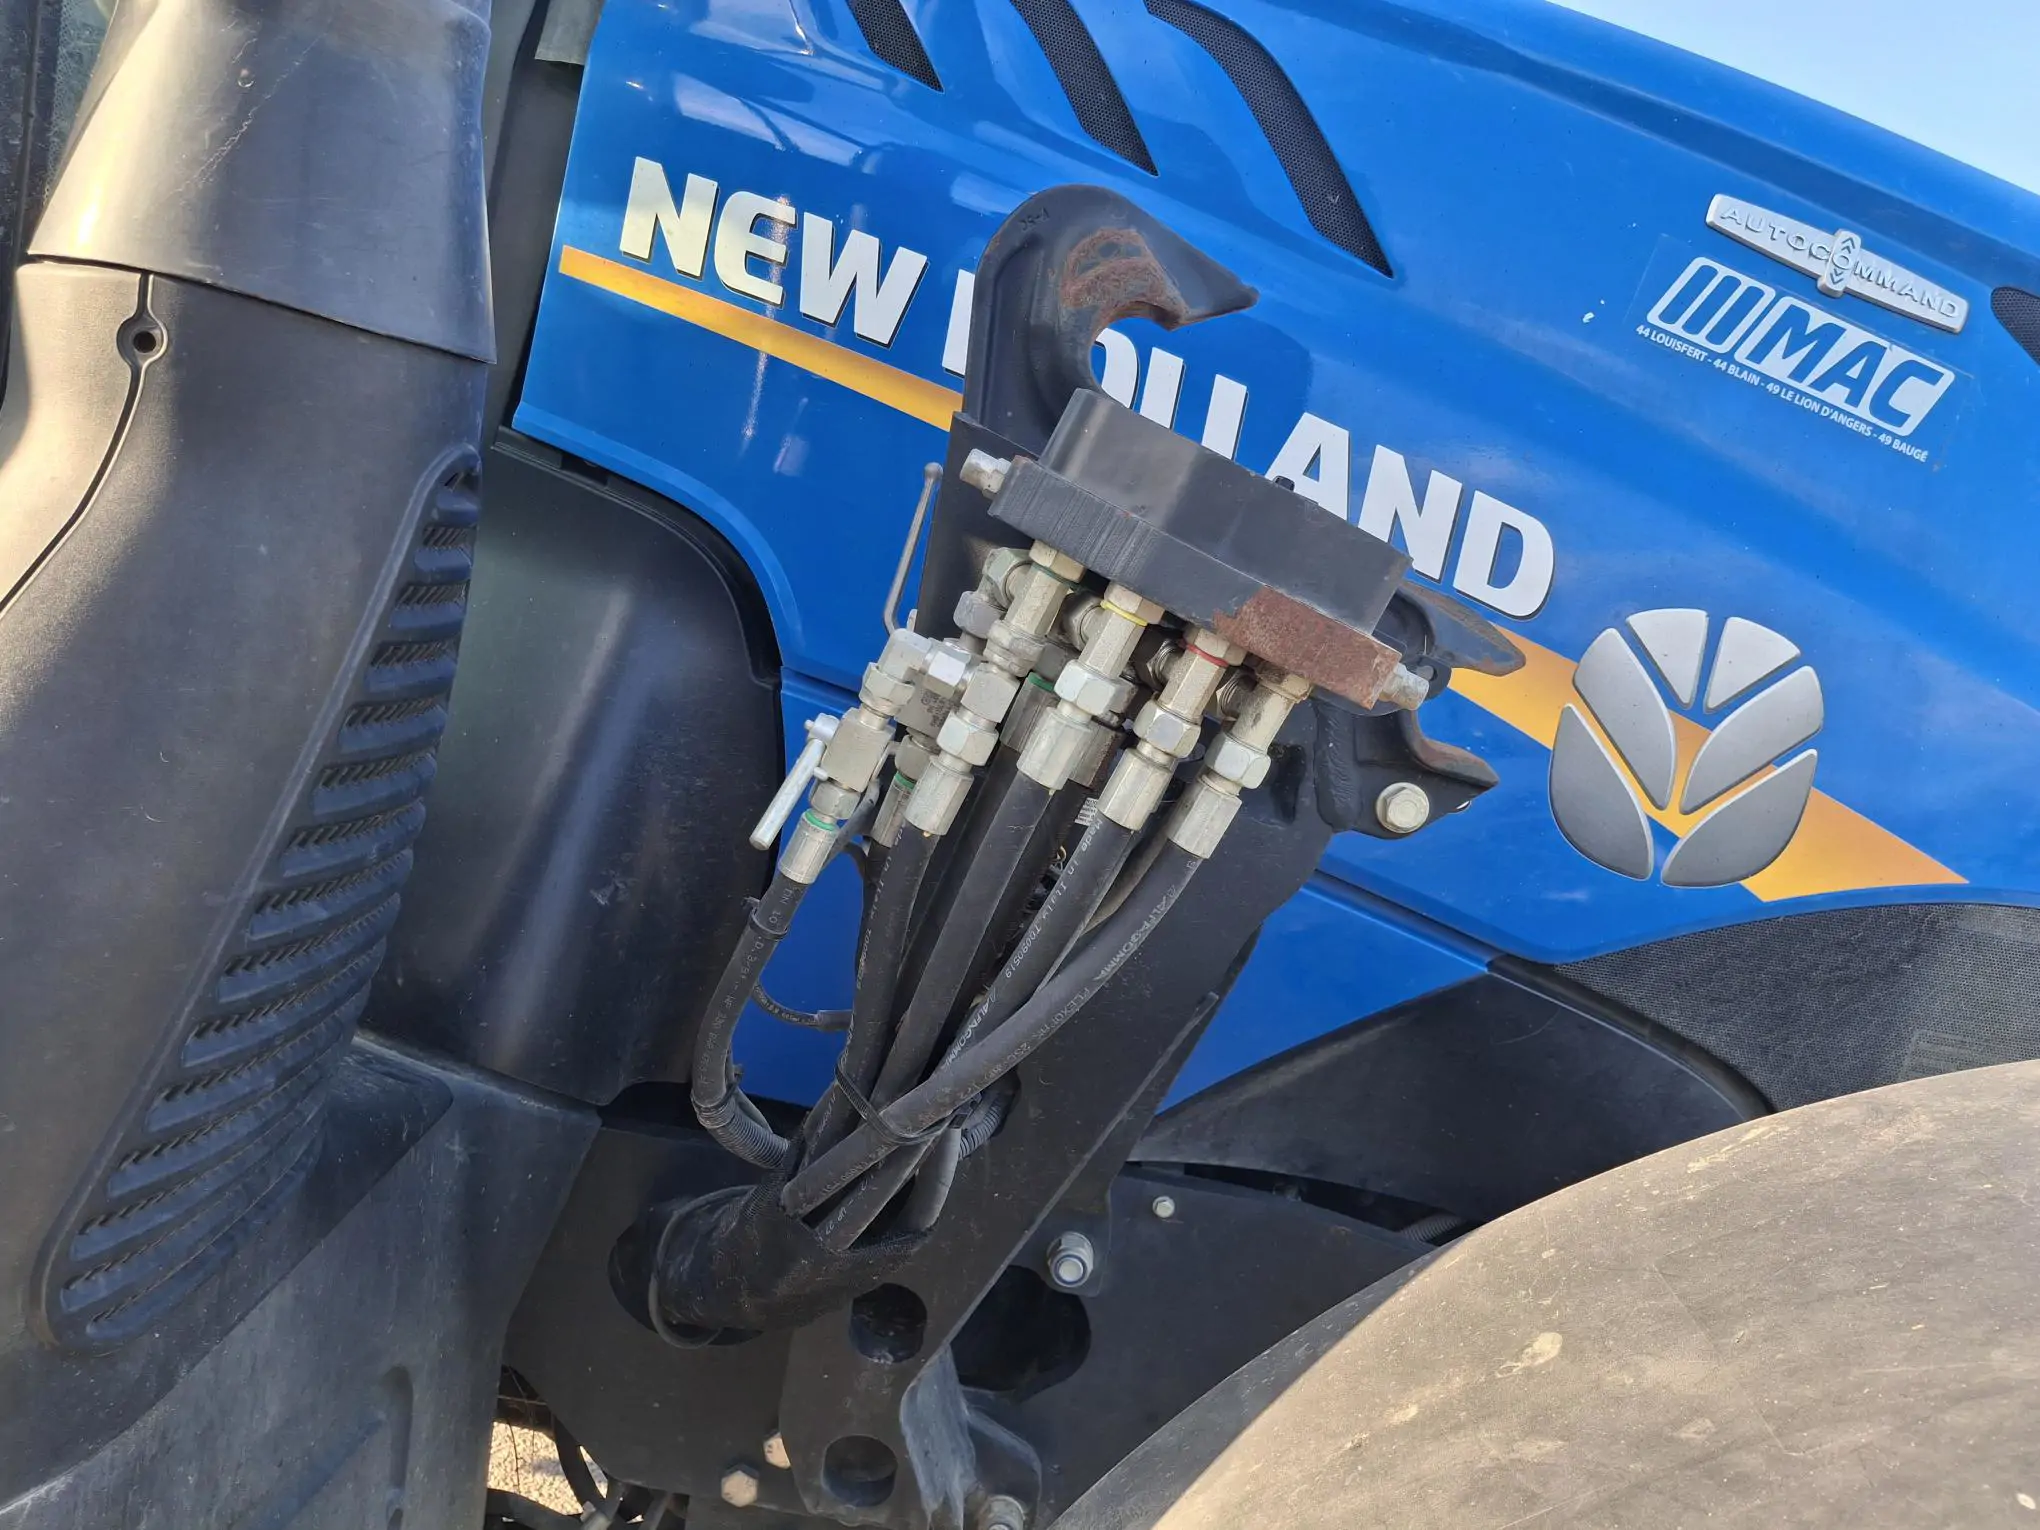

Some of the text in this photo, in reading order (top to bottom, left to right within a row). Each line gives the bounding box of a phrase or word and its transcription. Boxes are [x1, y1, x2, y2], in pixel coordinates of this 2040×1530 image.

[619, 156, 929, 350] NEW
[1721, 207, 1960, 318] AUTOCOMMAND
[1636, 325, 1650, 338] 44
[1650, 330, 1708, 362] LOUISFERT
[1713, 358, 1728, 372] 44
[1727, 365, 1761, 387] BLAIN
[1766, 382, 1780, 395] 49
[1781, 388, 1795, 402] LE
[1795, 394, 1821, 413] LION
[1821, 406, 1874, 437] D'ANGERS
[1878, 433, 1893, 446] 49
[1745, 304, 1945, 428] MAC
[1067, 860, 1079, 875] in
[1081, 819, 1103, 852] Made
